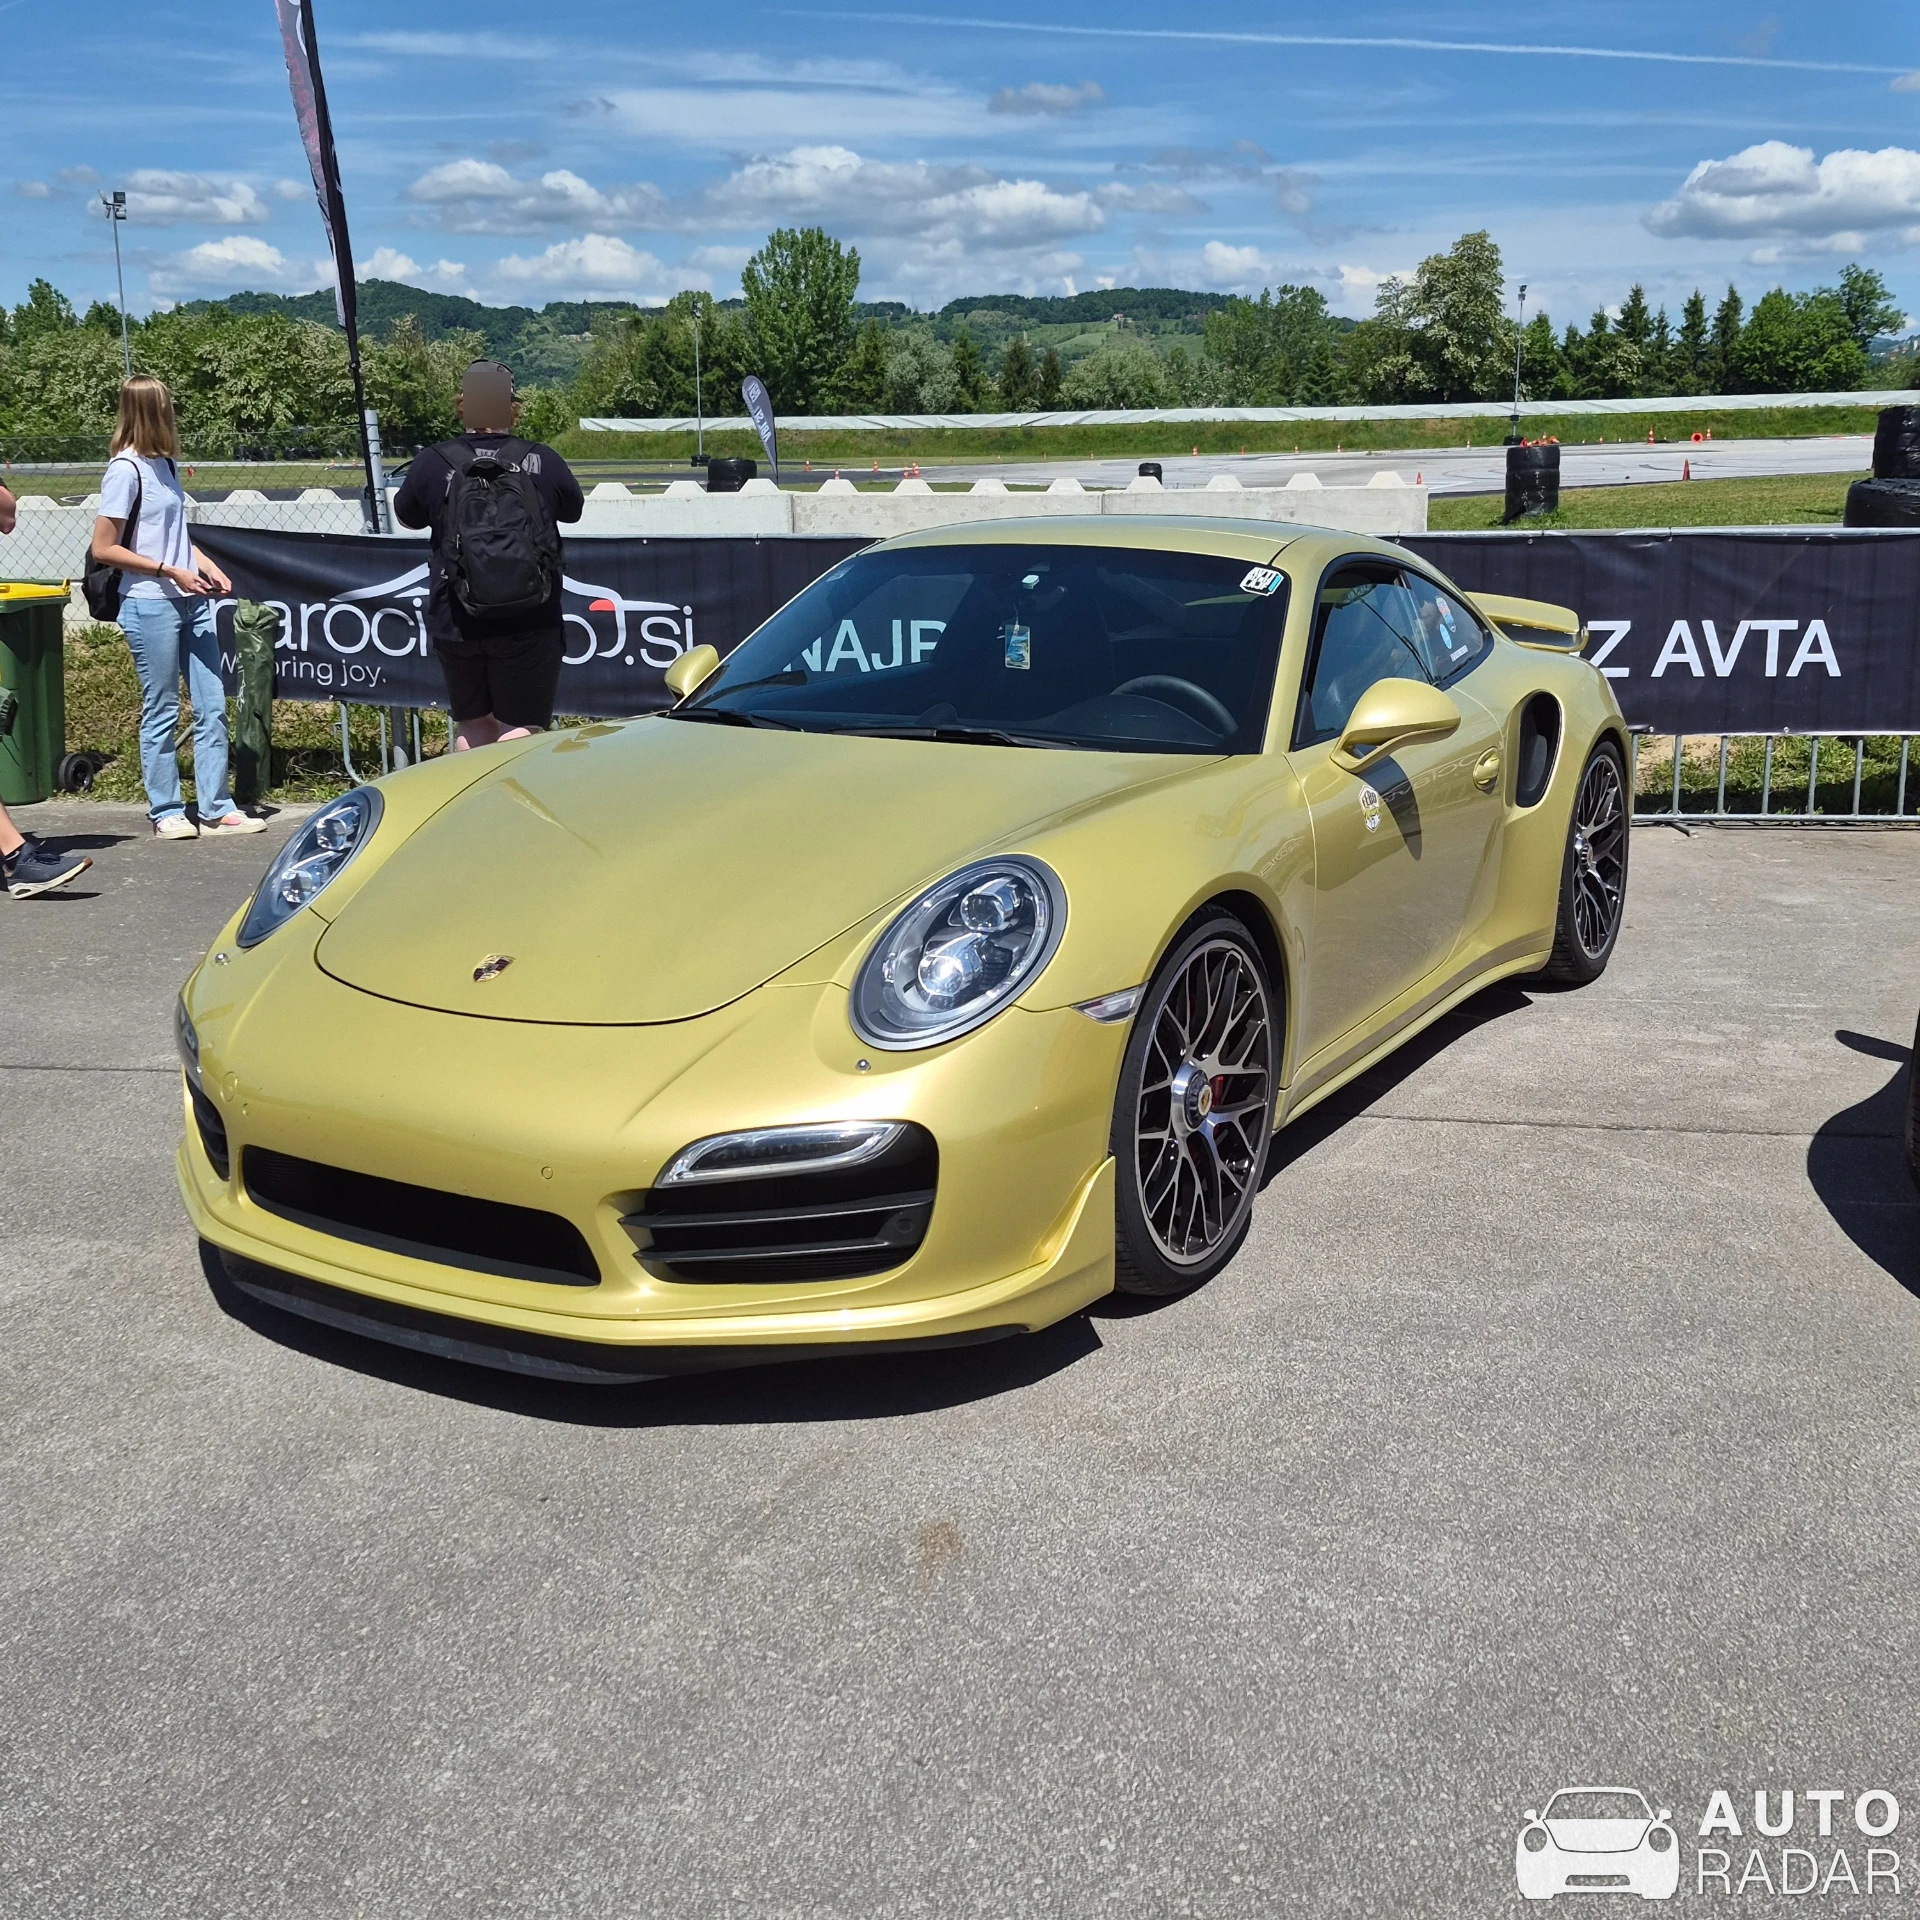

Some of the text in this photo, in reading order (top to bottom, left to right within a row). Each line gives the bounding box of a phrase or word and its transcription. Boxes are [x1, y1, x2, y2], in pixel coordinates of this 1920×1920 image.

[1568, 620, 1631, 677] Z
[1650, 619, 1842, 677] AVTA
[340, 658, 387, 688] joy.
